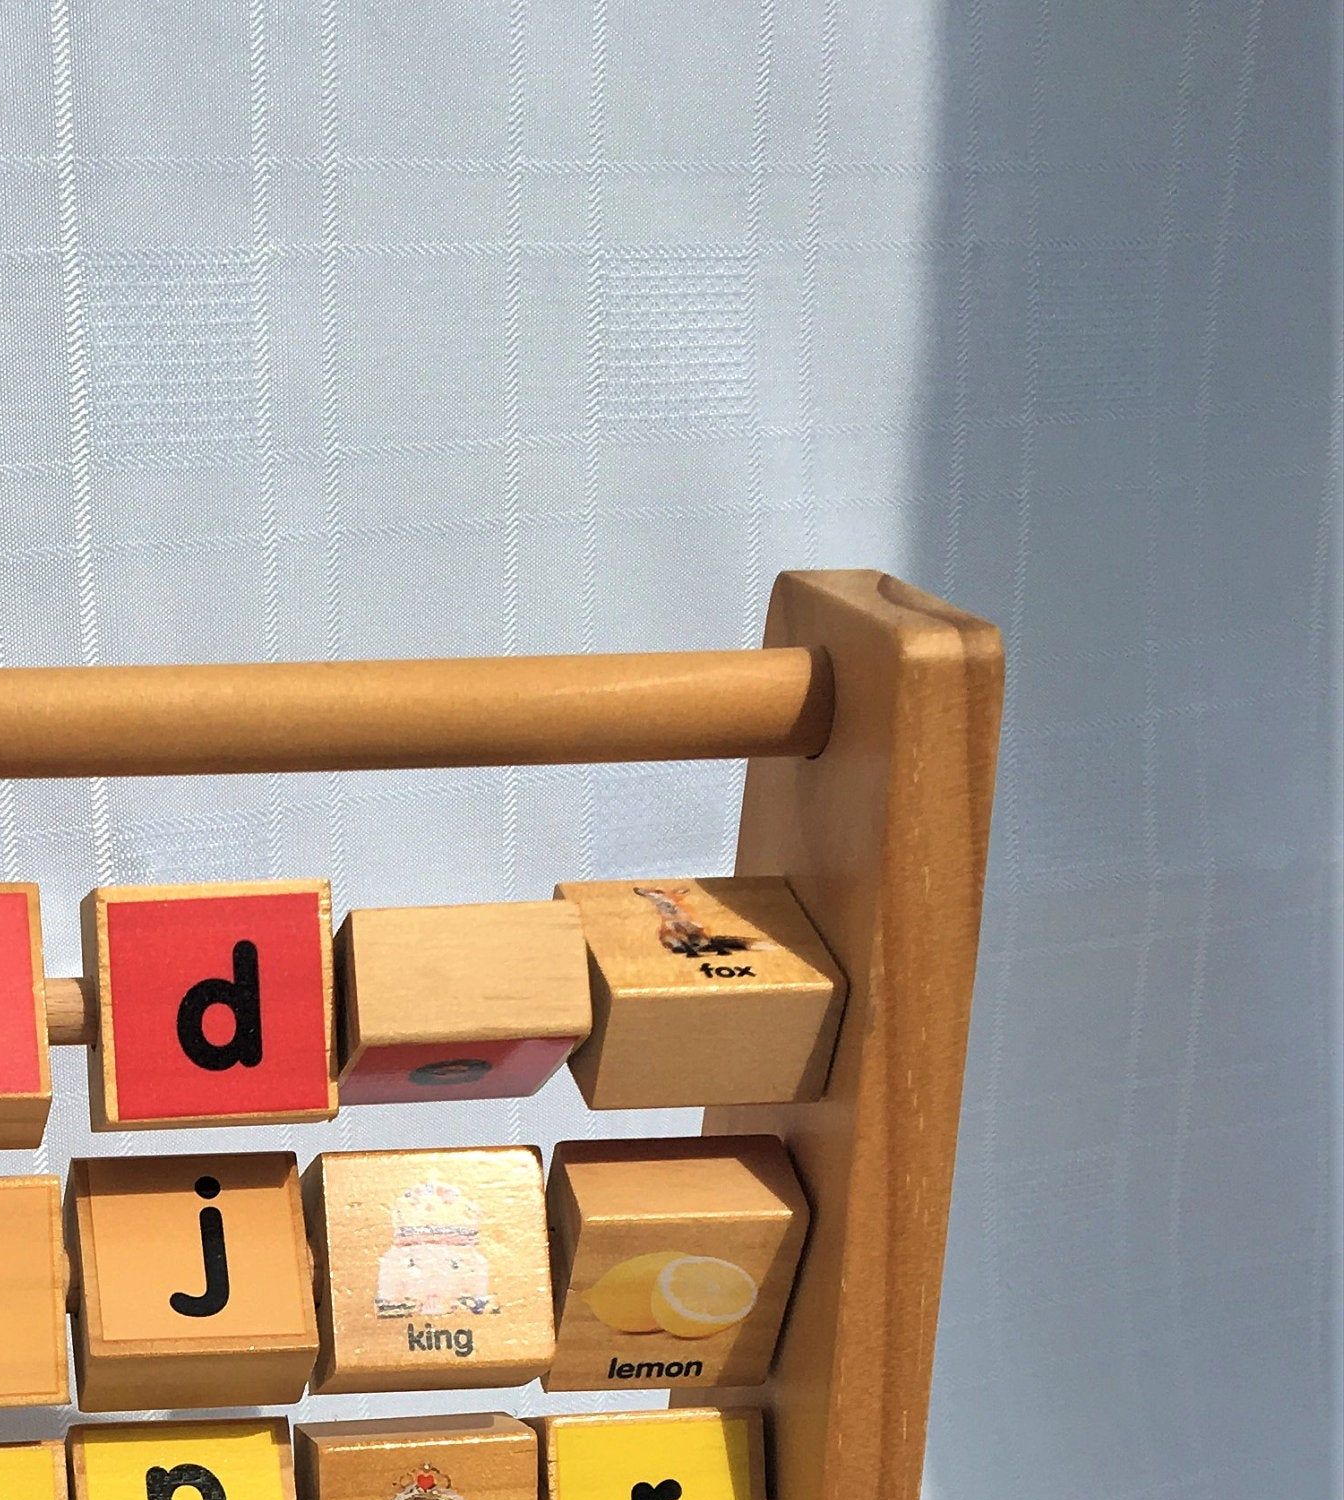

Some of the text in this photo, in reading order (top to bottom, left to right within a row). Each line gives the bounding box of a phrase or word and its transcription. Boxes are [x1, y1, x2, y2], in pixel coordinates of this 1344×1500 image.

[699, 960, 756, 980] fox
[177, 939, 263, 1071] d
[169, 1176, 230, 1317] j
[407, 1324, 474, 1357] king
[607, 1356, 703, 1382] lemon
